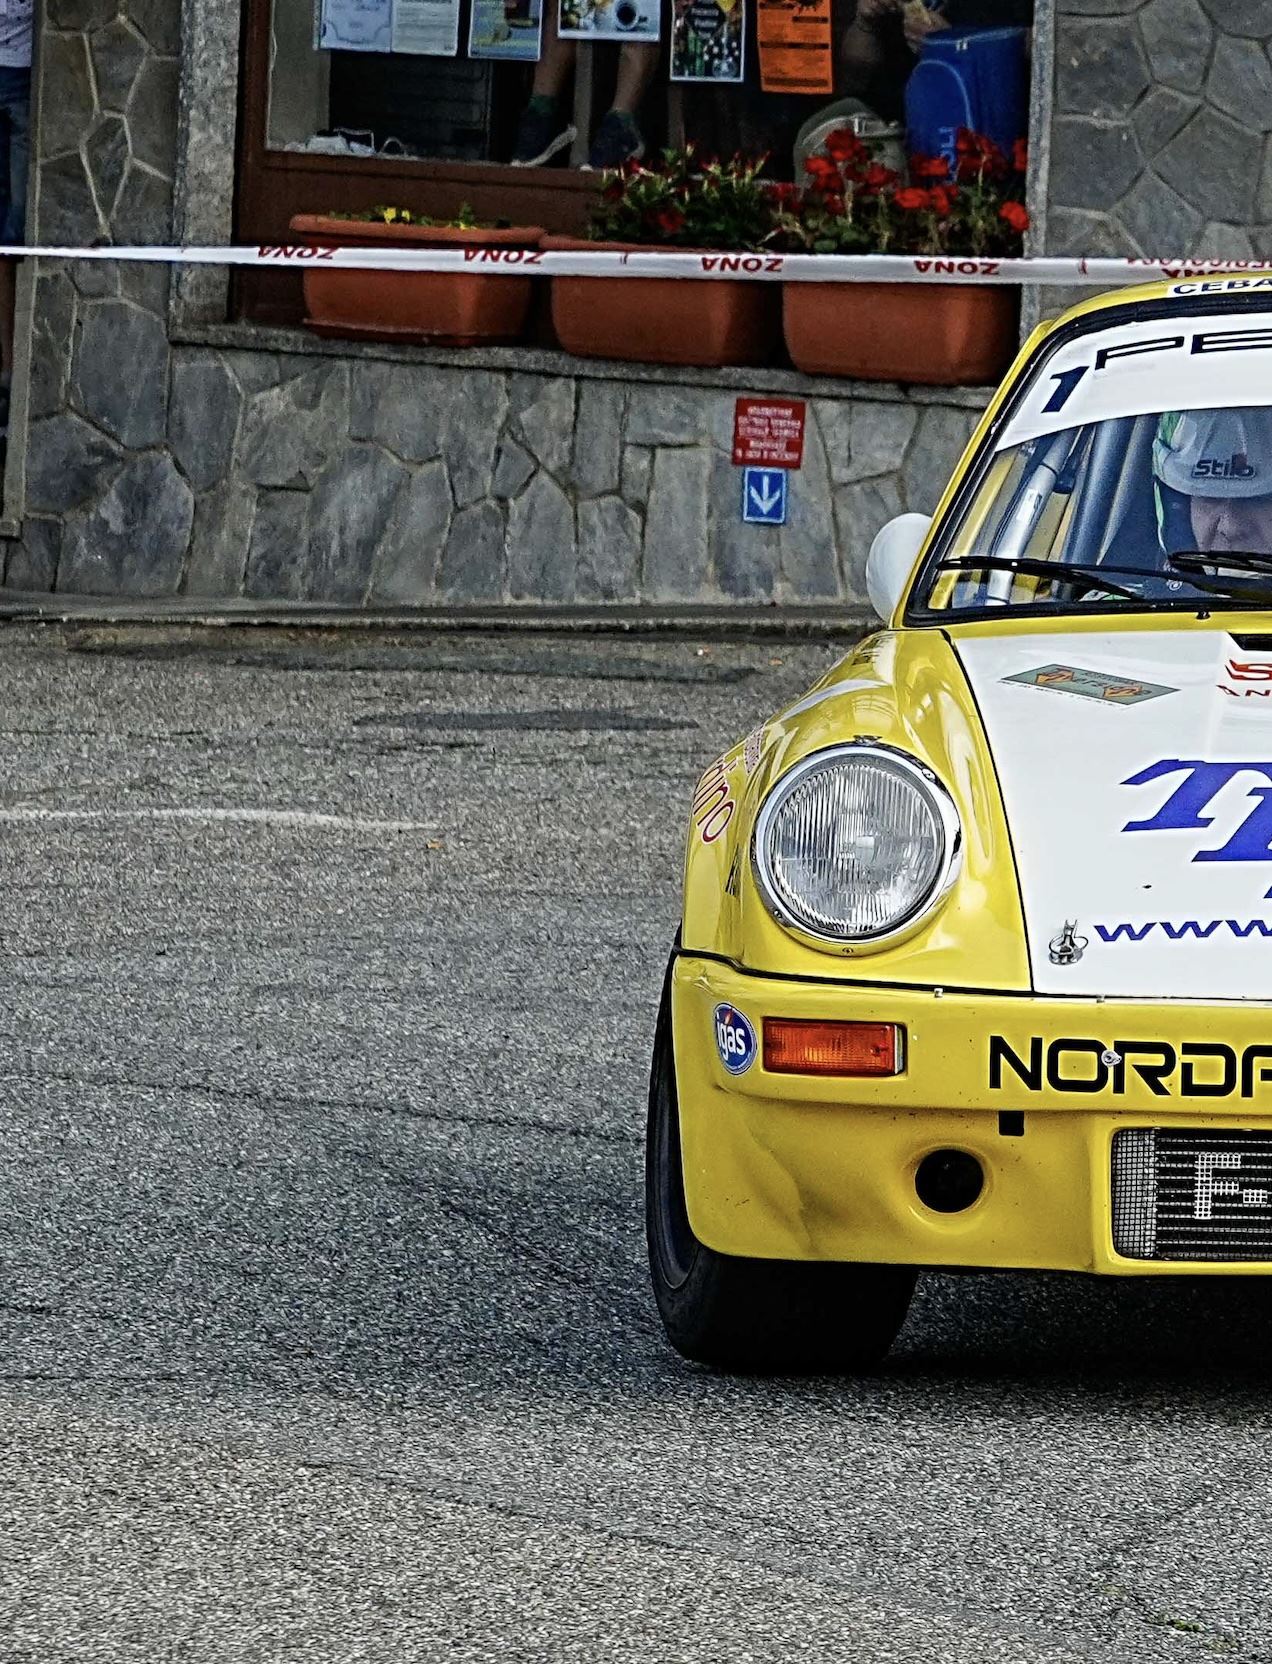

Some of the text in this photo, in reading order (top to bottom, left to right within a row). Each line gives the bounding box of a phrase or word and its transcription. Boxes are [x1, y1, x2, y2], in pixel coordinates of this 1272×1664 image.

[462, 248, 549, 264] ZONA
[701, 256, 784, 273] ZONA
[914, 260, 1000, 276] ZONA
[1041, 366, 1089, 413] 1
[716, 1011, 747, 1062] igas
